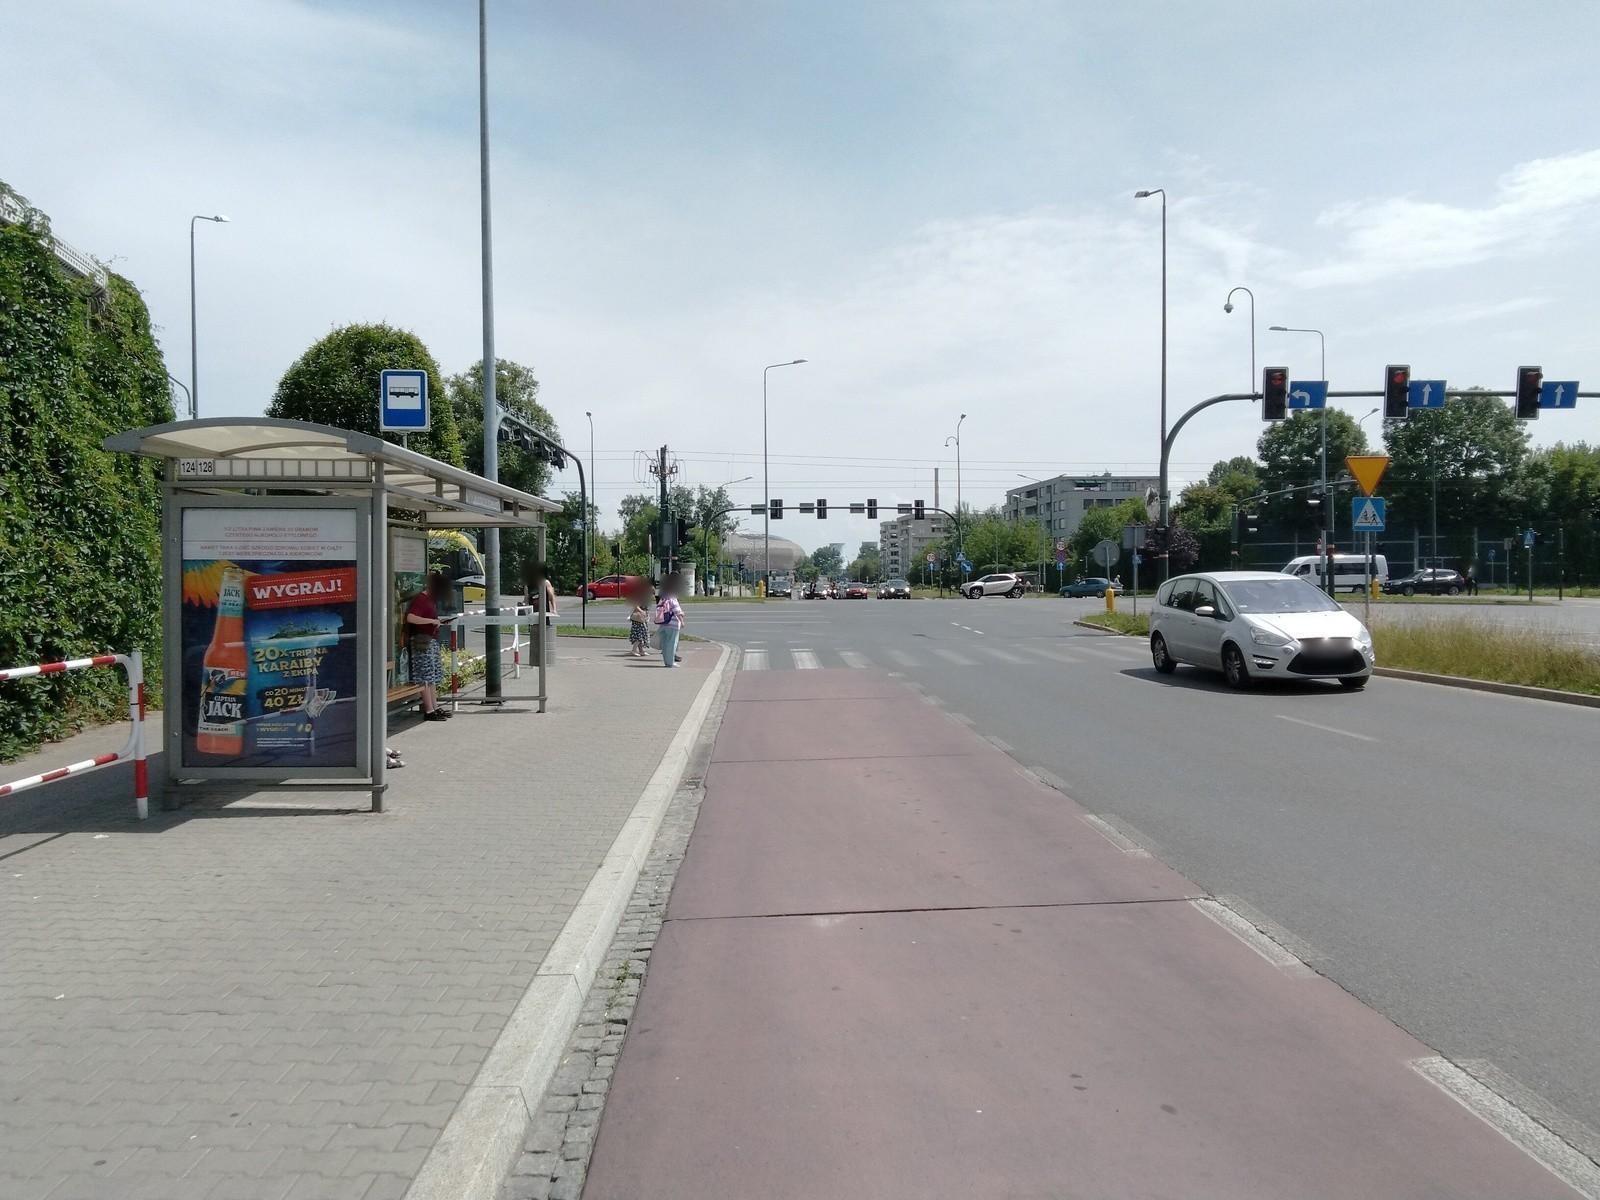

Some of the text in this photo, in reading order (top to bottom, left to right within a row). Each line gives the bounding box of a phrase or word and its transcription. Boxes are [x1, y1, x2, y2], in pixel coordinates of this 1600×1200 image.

[181, 461, 213, 473] 124 128
[223, 588, 241, 598] JACK
[253, 579, 342, 600] WYGRAJ!
[289, 649, 312, 658] TRIP
[313, 647, 329, 655] NA
[258, 656, 324, 673] KARAIBY
[274, 687, 289, 697] 20
[264, 696, 285, 708] 40
[206, 700, 242, 719] JACK
